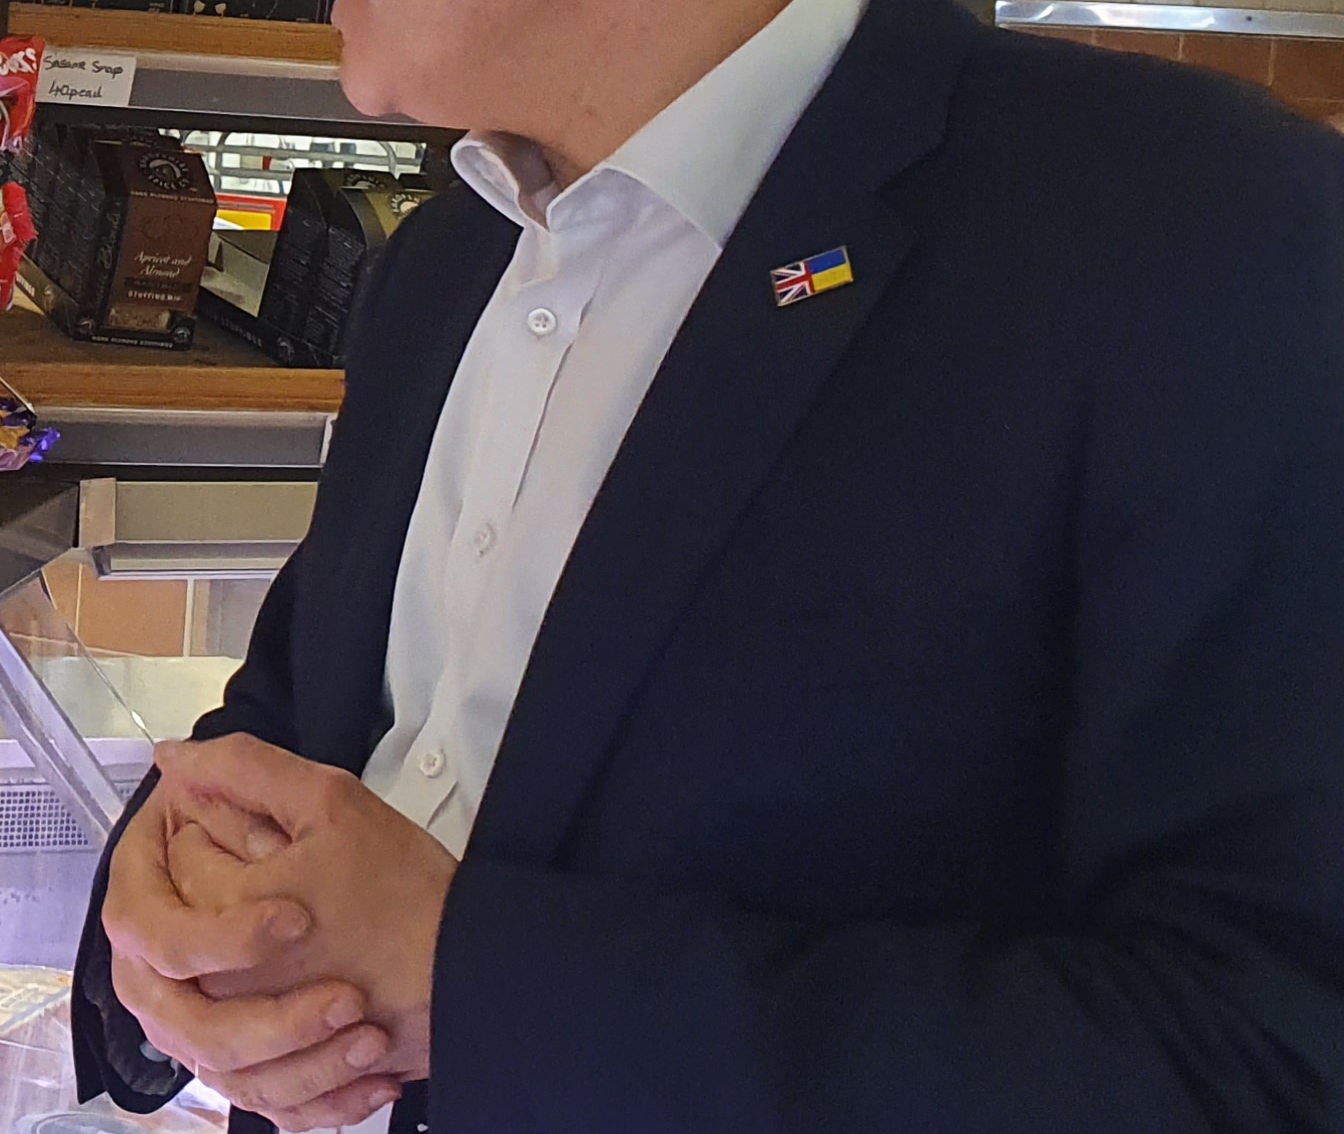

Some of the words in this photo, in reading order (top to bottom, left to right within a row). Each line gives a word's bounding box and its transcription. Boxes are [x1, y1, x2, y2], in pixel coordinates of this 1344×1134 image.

[134, 251, 170, 264] Apricot
[171, 255, 192, 266] and
[139, 265, 181, 278] Almond
